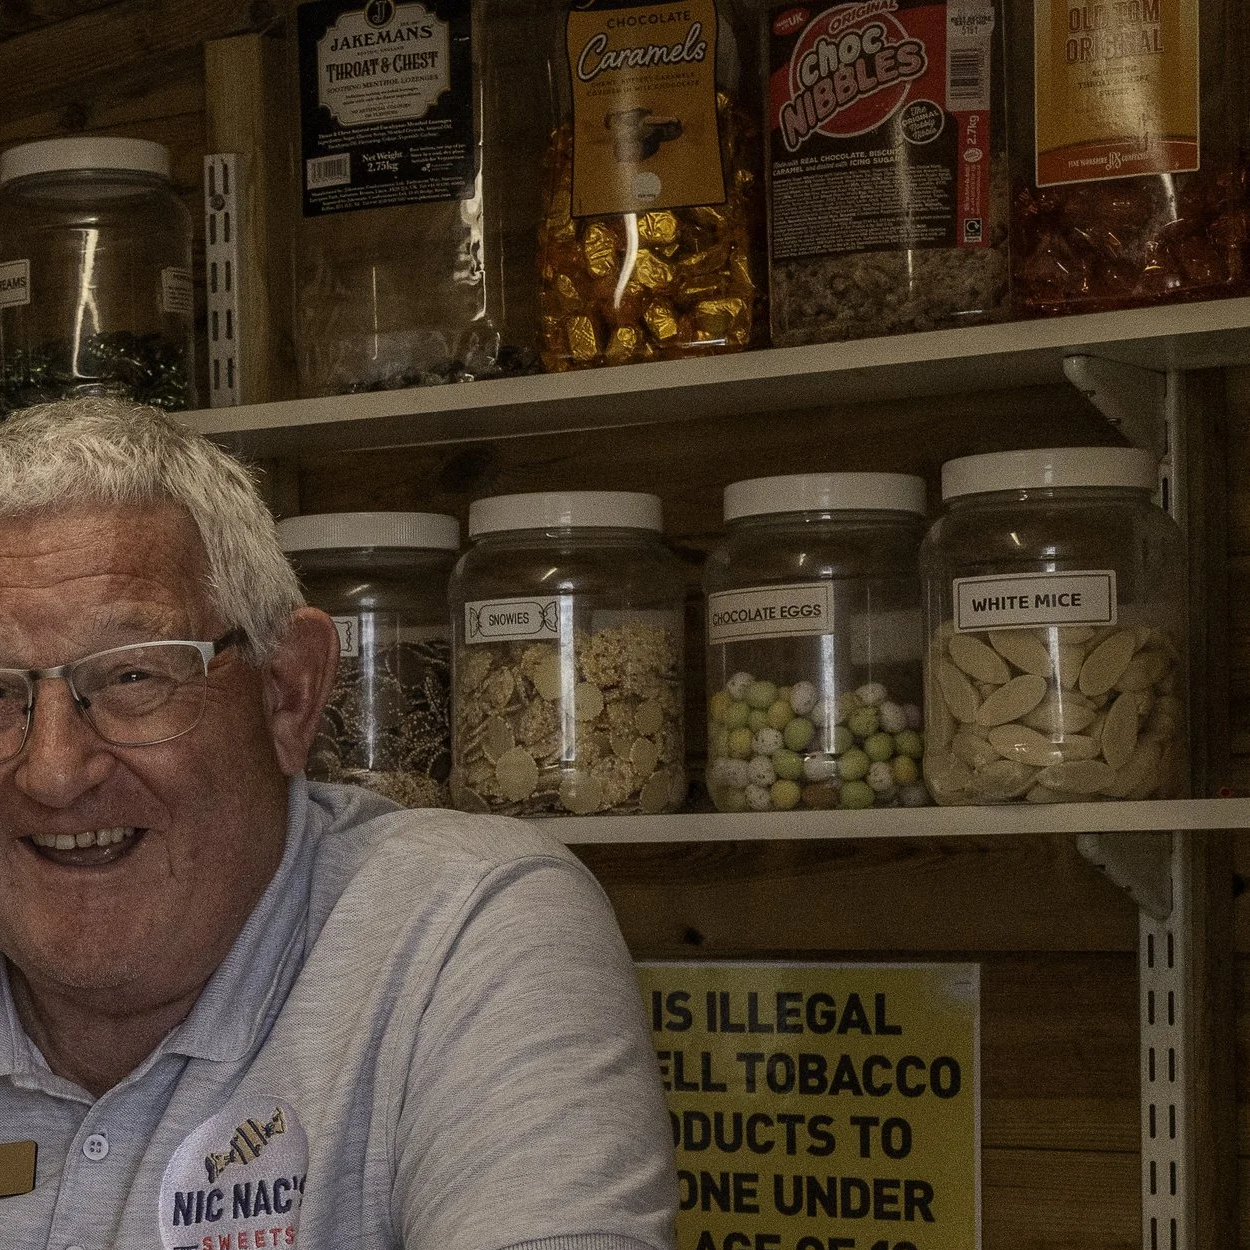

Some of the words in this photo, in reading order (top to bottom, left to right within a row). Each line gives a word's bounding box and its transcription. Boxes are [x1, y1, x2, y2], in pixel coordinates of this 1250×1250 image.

[606, 11, 691, 28] CHOCOLATE
[788, 12, 803, 26] UK
[829, 1, 900, 33] ORIGINAL
[331, 25, 434, 52] JAKEMANS
[577, 21, 708, 81] Caramels
[326, 57, 379, 83] THROAT
[381, 57, 391, 73] &
[393, 51, 439, 72] CHEST
[363, 79, 399, 89] MENTHOL
[401, 74, 439, 84] LOZENGES
[783, 43, 924, 147] NIBBLES
[901, 110, 940, 127] ORIGINAL
[966, 115, 980, 145] 2.7kg
[362, 153, 377, 162] Net
[378, 150, 403, 162] Weight
[367, 161, 399, 173] 2.75kg
[800, 157, 819, 166] REAL
[820, 151, 868, 163] CHOCOLATE,
[850, 157, 870, 167] ICING
[712, 606, 776, 626] CHOCOLATE
[780, 602, 822, 620] EGGS
[972, 596, 1029, 613] WHITE
[1034, 593, 1082, 609] MICE
[488, 612, 530, 627] SNOWIES
[652, 990, 693, 1032] IS
[706, 990, 903, 1036] ILLEGAL
[736, 1052, 961, 1099] TOBACCO
[850, 1115, 912, 1159] TO
[173, 1187, 224, 1227] NIC
[773, 1173, 936, 1222] UNDER
